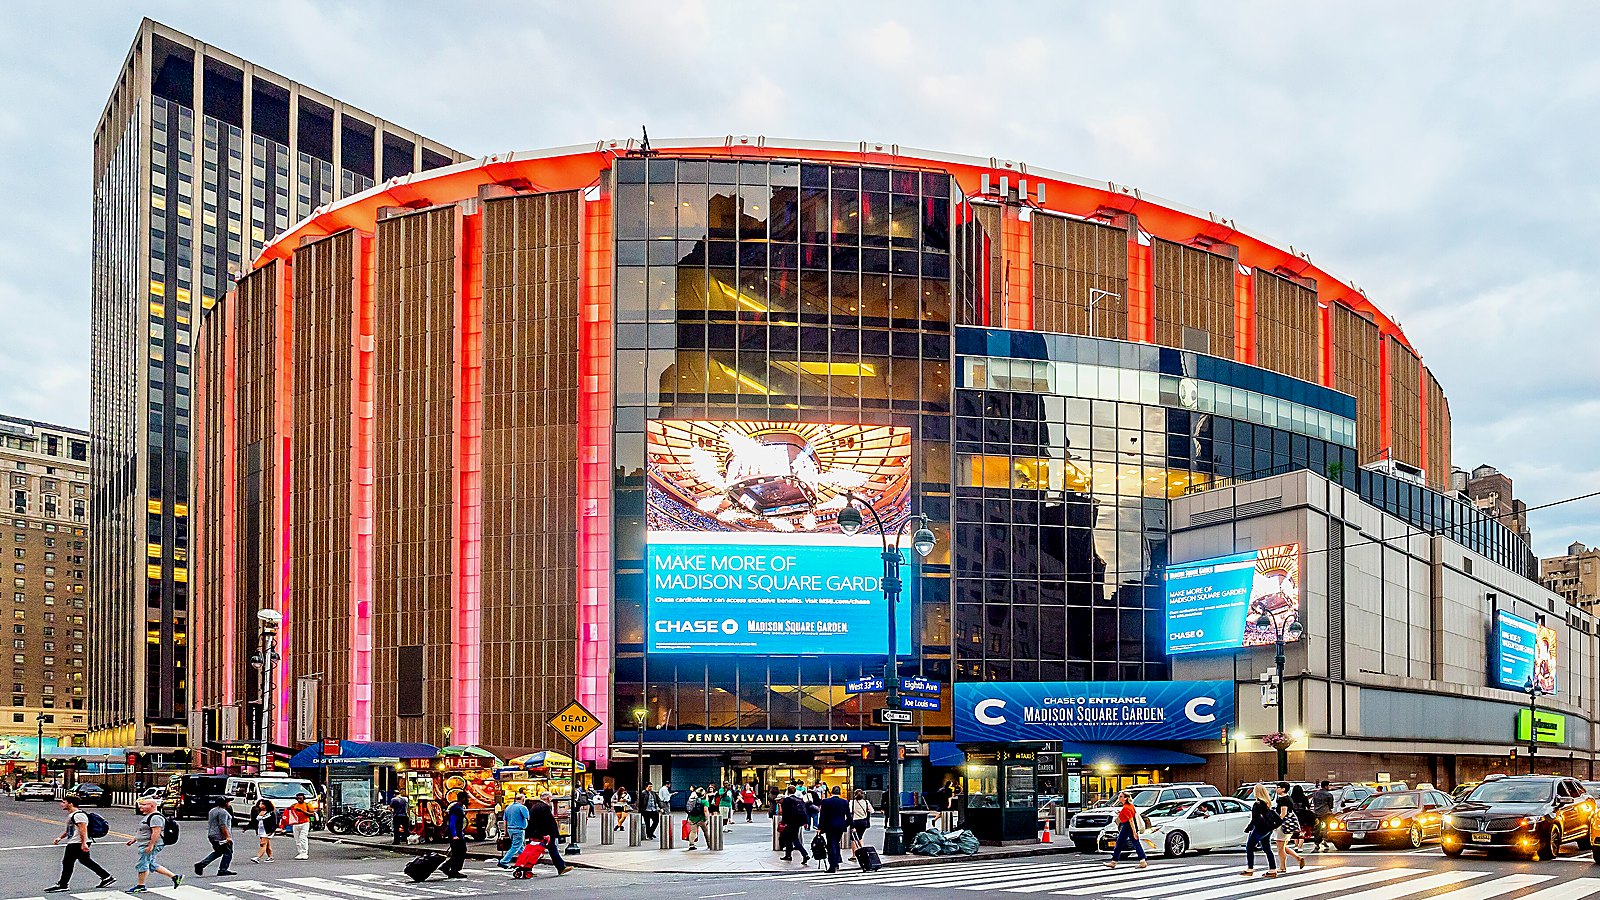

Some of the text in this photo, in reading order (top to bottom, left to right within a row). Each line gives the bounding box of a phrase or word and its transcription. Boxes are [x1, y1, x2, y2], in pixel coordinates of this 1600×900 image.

[655, 555, 797, 572] MAKE MORE OF
[655, 574, 884, 593] MADISON SQUARE GARDE
[1169, 587, 1247, 604] MADISON SQUARE GARDEN
[1186, 587, 1203, 595] MORE
[655, 620, 719, 633] CHASE
[747, 620, 784, 632] MADISON
[785, 620, 816, 634] SQUARE
[1169, 631, 1195, 640] CHASE
[849, 683, 864, 691] West
[875, 681, 883, 689] St
[904, 680, 938, 691] Eighth Ave
[904, 699, 914, 707] Joe
[914, 699, 929, 708] Louis
[1043, 696, 1147, 705] CHASE ENTRANCE
[1023, 706, 1074, 722] MADISON
[1076, 705, 1119, 722] SQUARE
[561, 714, 588, 723] DEAD
[564, 724, 585, 733] END
[687, 733, 848, 742] PENNSYLVANIA STATION
[410, 759, 430, 768] HOT DOG
